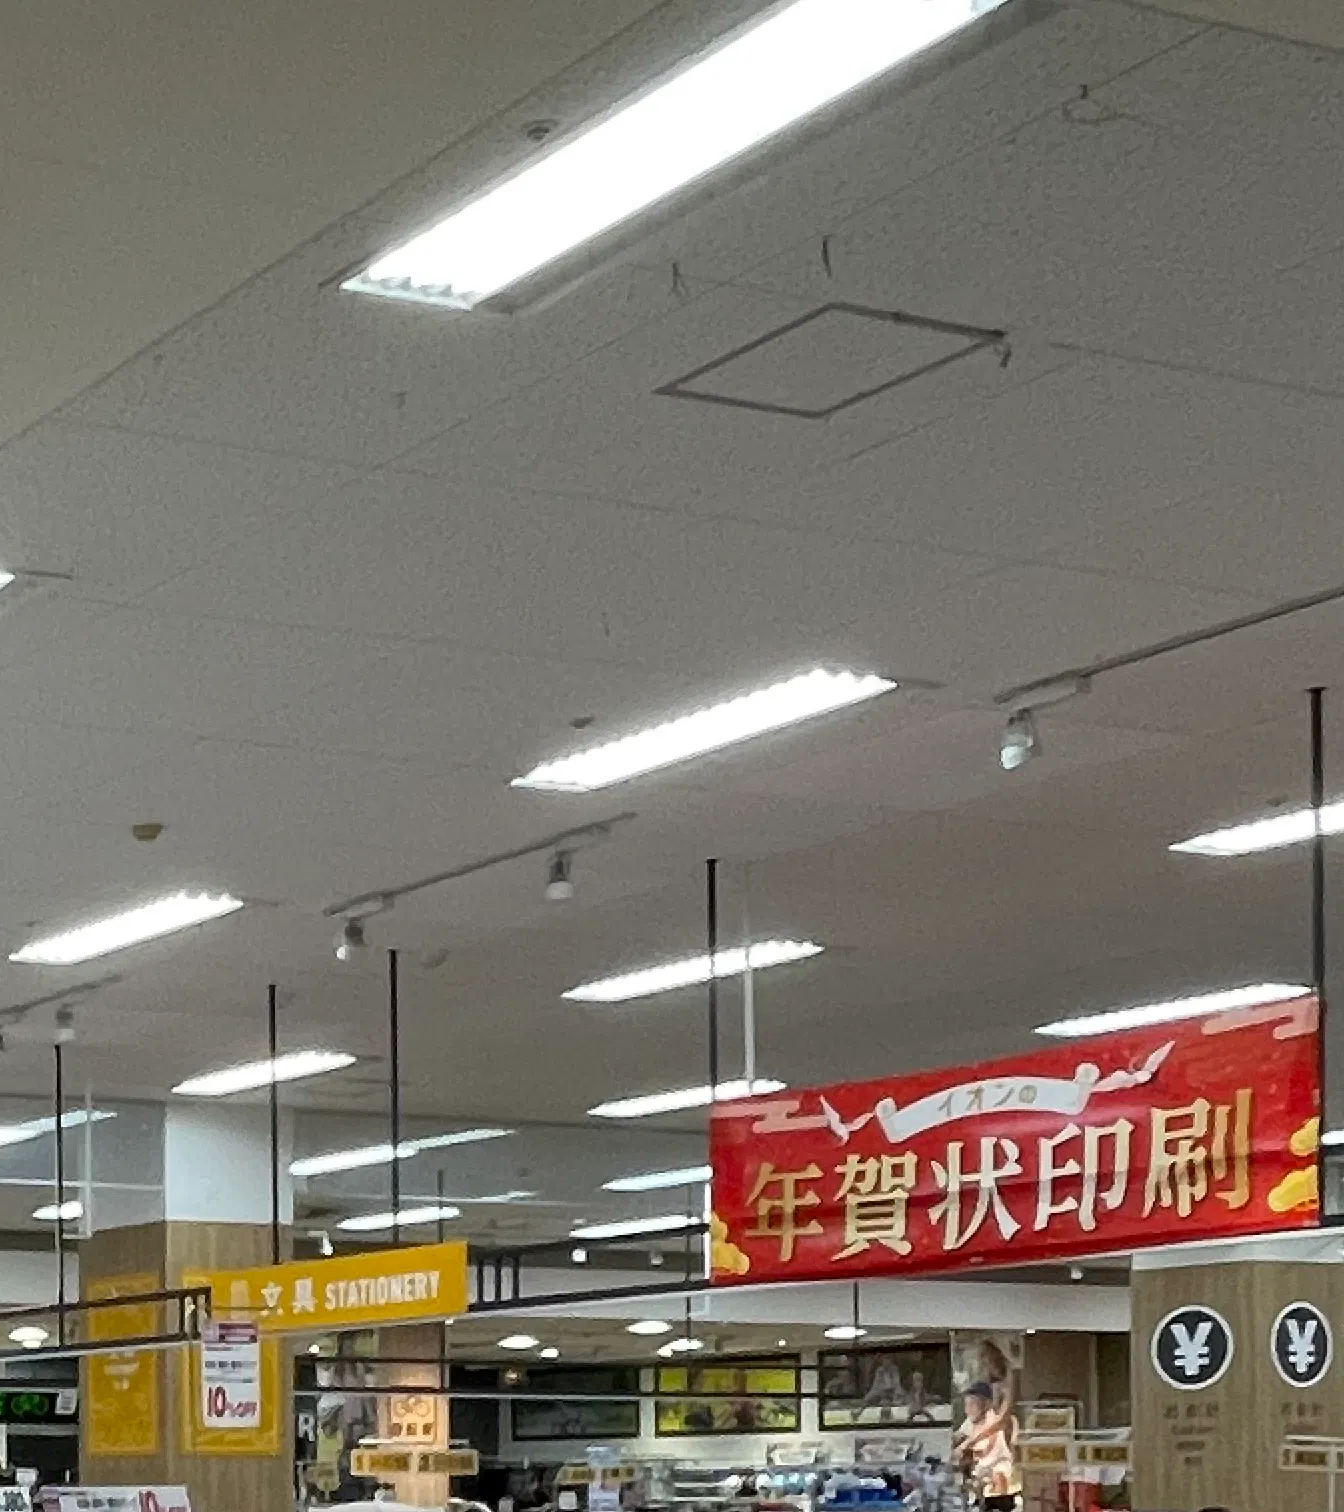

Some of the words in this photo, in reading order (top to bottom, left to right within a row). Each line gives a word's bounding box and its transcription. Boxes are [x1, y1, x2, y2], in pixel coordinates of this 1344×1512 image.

[938, 1082, 1038, 1117] イオンの
[744, 1088, 1253, 1262] 年賀状印刷
[324, 1270, 440, 1311] STATIONERY
